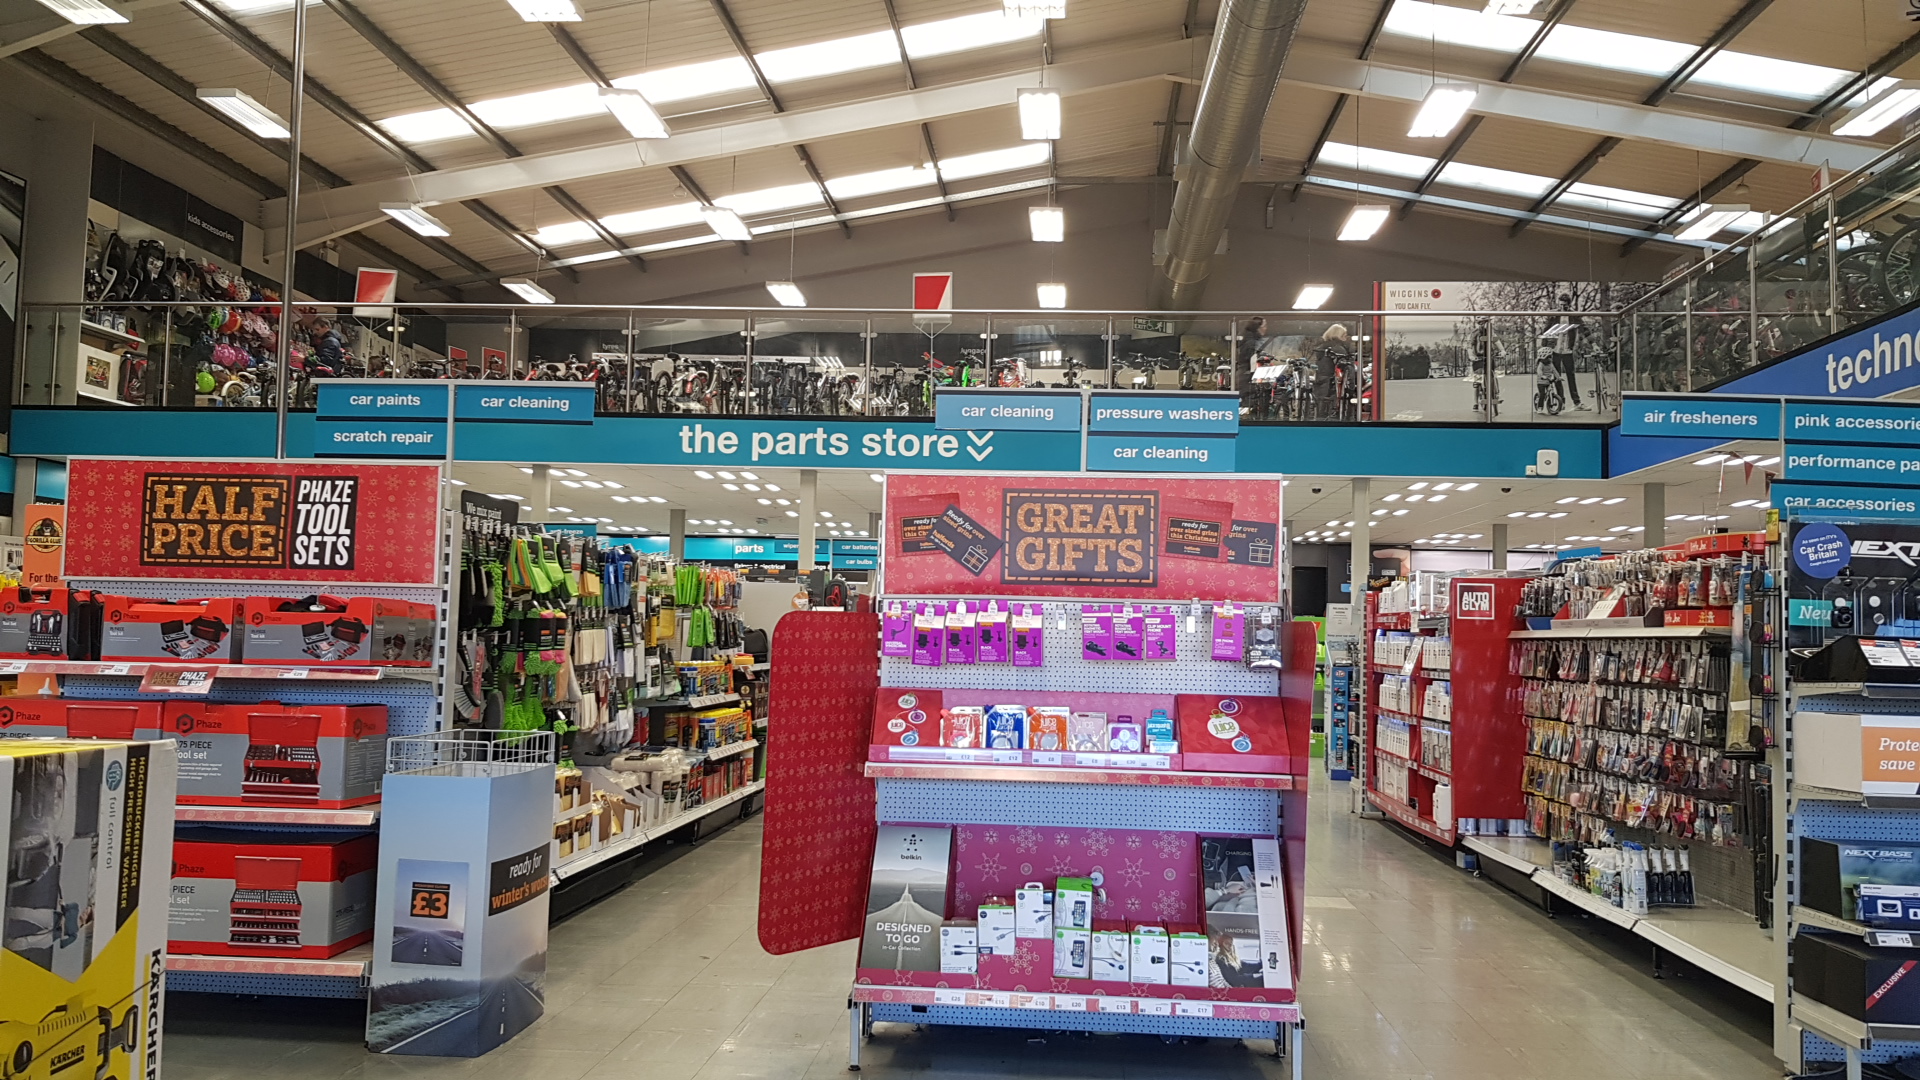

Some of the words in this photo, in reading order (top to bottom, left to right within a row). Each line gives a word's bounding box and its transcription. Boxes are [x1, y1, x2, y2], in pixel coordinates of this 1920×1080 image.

[187, 212, 200, 226] kids
[201, 221, 234, 241] accessories
[1390, 290, 1429, 298] WIGGINS
[1395, 302, 1406, 310] YOU
[1407, 302, 1419, 310] CAN
[1420, 302, 1432, 310] FLY.
[350, 394, 373, 405] car
[376, 393, 421, 408] paints
[481, 396, 506, 407] car
[508, 396, 570, 412] cleaning
[961, 406, 986, 417] car
[989, 405, 1054, 421] cleaning
[1096, 407, 1163, 422] pressure
[1168, 408, 1234, 421] washers
[1644, 410, 1666, 423] air
[1669, 409, 1758, 426] fresheners
[1794, 413, 1830, 431] pink
[333, 430, 387, 443] scratch
[391, 431, 434, 446] repair
[679, 424, 739, 454] the
[752, 427, 849, 462] parts
[862, 428, 959, 458] store
[1113, 447, 1139, 459] car
[1143, 446, 1209, 462] cleaning
[1788, 454, 1897, 471] performance
[152, 485, 280, 521] HALF
[298, 479, 352, 503] PHAZE
[1784, 496, 1811, 508] car
[1816, 497, 1916, 512] accessories
[466, 502, 477, 515] We
[476, 505, 488, 516] mix
[946, 509, 965, 525] Ready
[963, 522, 973, 531] for
[972, 529, 986, 540] over
[1016, 502, 1145, 534] GREAT
[150, 522, 278, 557] PRICE
[297, 502, 352, 536] TOOL
[942, 515, 958, 529] sized
[956, 527, 973, 540] grins
[932, 529, 956, 548] halfords
[1184, 534, 1216, 543] Christmas
[293, 535, 350, 567] SETS
[735, 544, 764, 555] parts
[1015, 536, 1144, 574] GIFTS
[1800, 546, 1816, 555] Car
[1817, 541, 1843, 552] Crash
[1809, 550, 1838, 561] Britain
[29, 573, 44, 582] For
[45, 574, 58, 583] the
[1462, 591, 1489, 601] AUTO
[1462, 600, 1489, 611] GLYM
[153, 671, 179, 679] HALF
[179, 671, 209, 680] PHAZE
[16, 711, 41, 721] Phaze
[196, 719, 222, 729] Phaze
[189, 741, 213, 749] PIECE
[193, 751, 208, 760] set
[129, 758, 137, 788] HIGH
[1879, 760, 1916, 771] save
[109, 797, 117, 818] full
[125, 791, 135, 853] PRESSURE
[130, 756, 146, 887] HOCHDRUCKREINIGER
[106, 822, 116, 869] control
[900, 853, 922, 861] belkin
[179, 864, 205, 874] Phaze
[509, 855, 533, 879] ready
[530, 852, 542, 870] for
[120, 856, 131, 909] WASHER
[172, 885, 196, 894] PIECE
[176, 895, 190, 905] set
[492, 881, 531, 910] winter's
[530, 875, 549, 895] worst
[412, 891, 447, 917] £3
[876, 922, 932, 934] DESIGNED
[1224, 927, 1258, 935] HANDS-FREE
[885, 933, 899, 943] TO
[903, 934, 921, 944] GO
[1873, 967, 1907, 999] EXCLUSIVE
